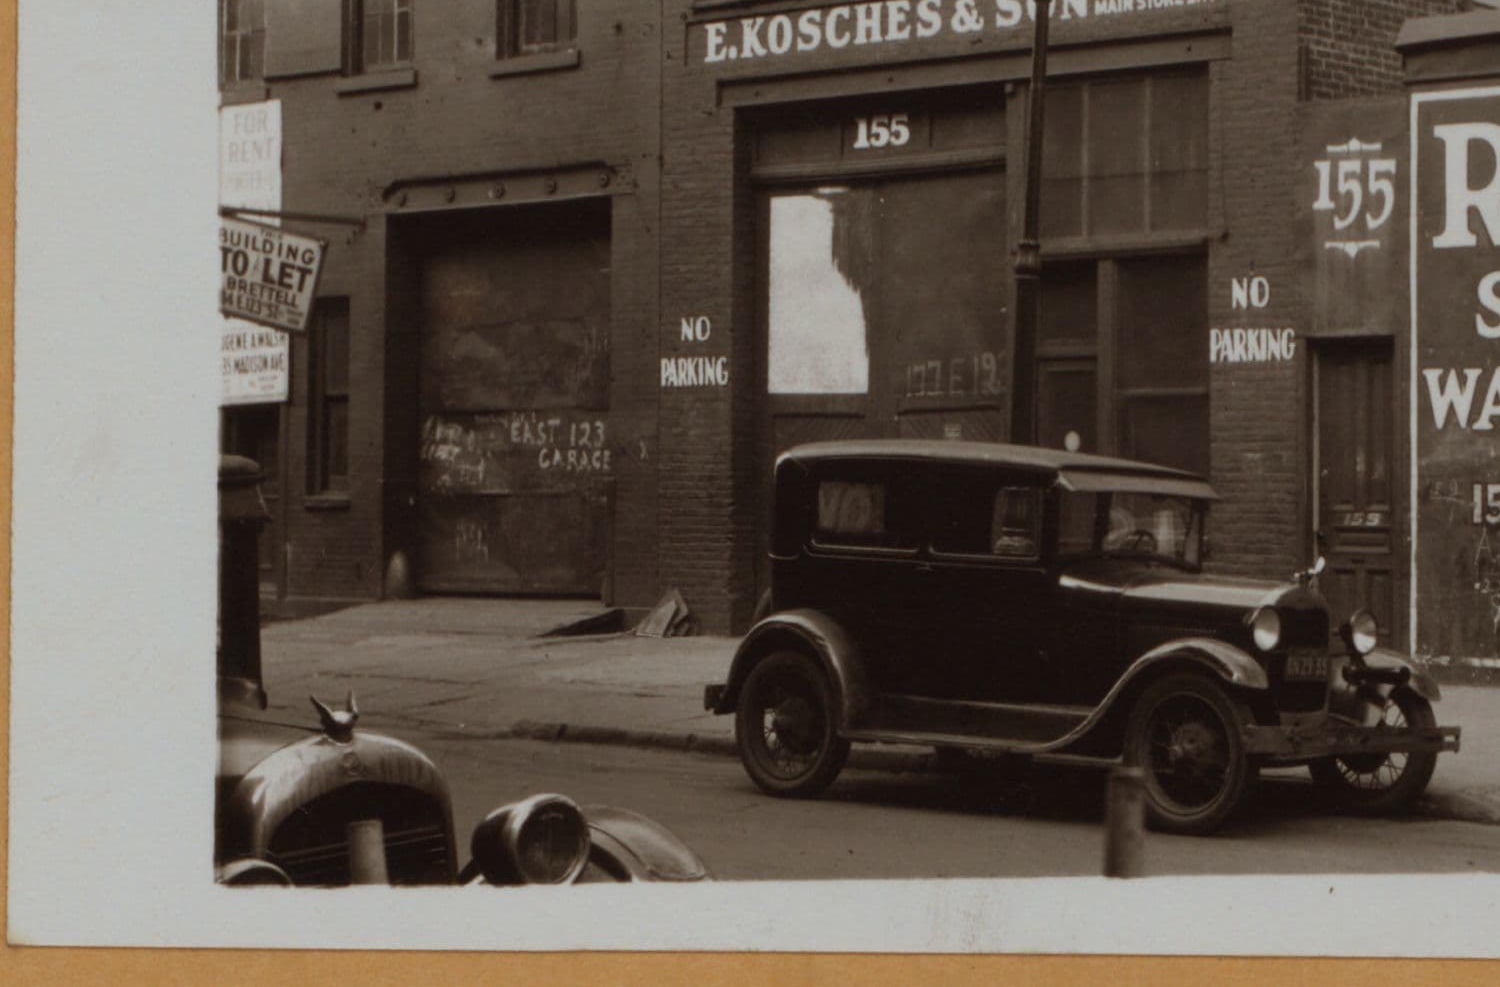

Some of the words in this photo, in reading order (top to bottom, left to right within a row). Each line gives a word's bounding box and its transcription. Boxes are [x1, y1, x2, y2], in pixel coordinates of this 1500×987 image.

[233, 109, 268, 134] FOR
[853, 117, 910, 149] 155
[228, 136, 274, 162] RENT
[1312, 159, 1396, 230] 155
[220, 226, 316, 266] BUILDING
[219, 246, 249, 277] TO
[261, 257, 314, 293] LET
[226, 275, 299, 308] BRETTELL
[1231, 277, 1270, 309] NO
[681, 316, 711, 342] NO
[1210, 328, 1296, 363] PARKING
[661, 356, 729, 387] PARKING
[510, 418, 561, 446] EAST
[570, 420, 605, 447] 123
[538, 447, 611, 472] GARAGE
